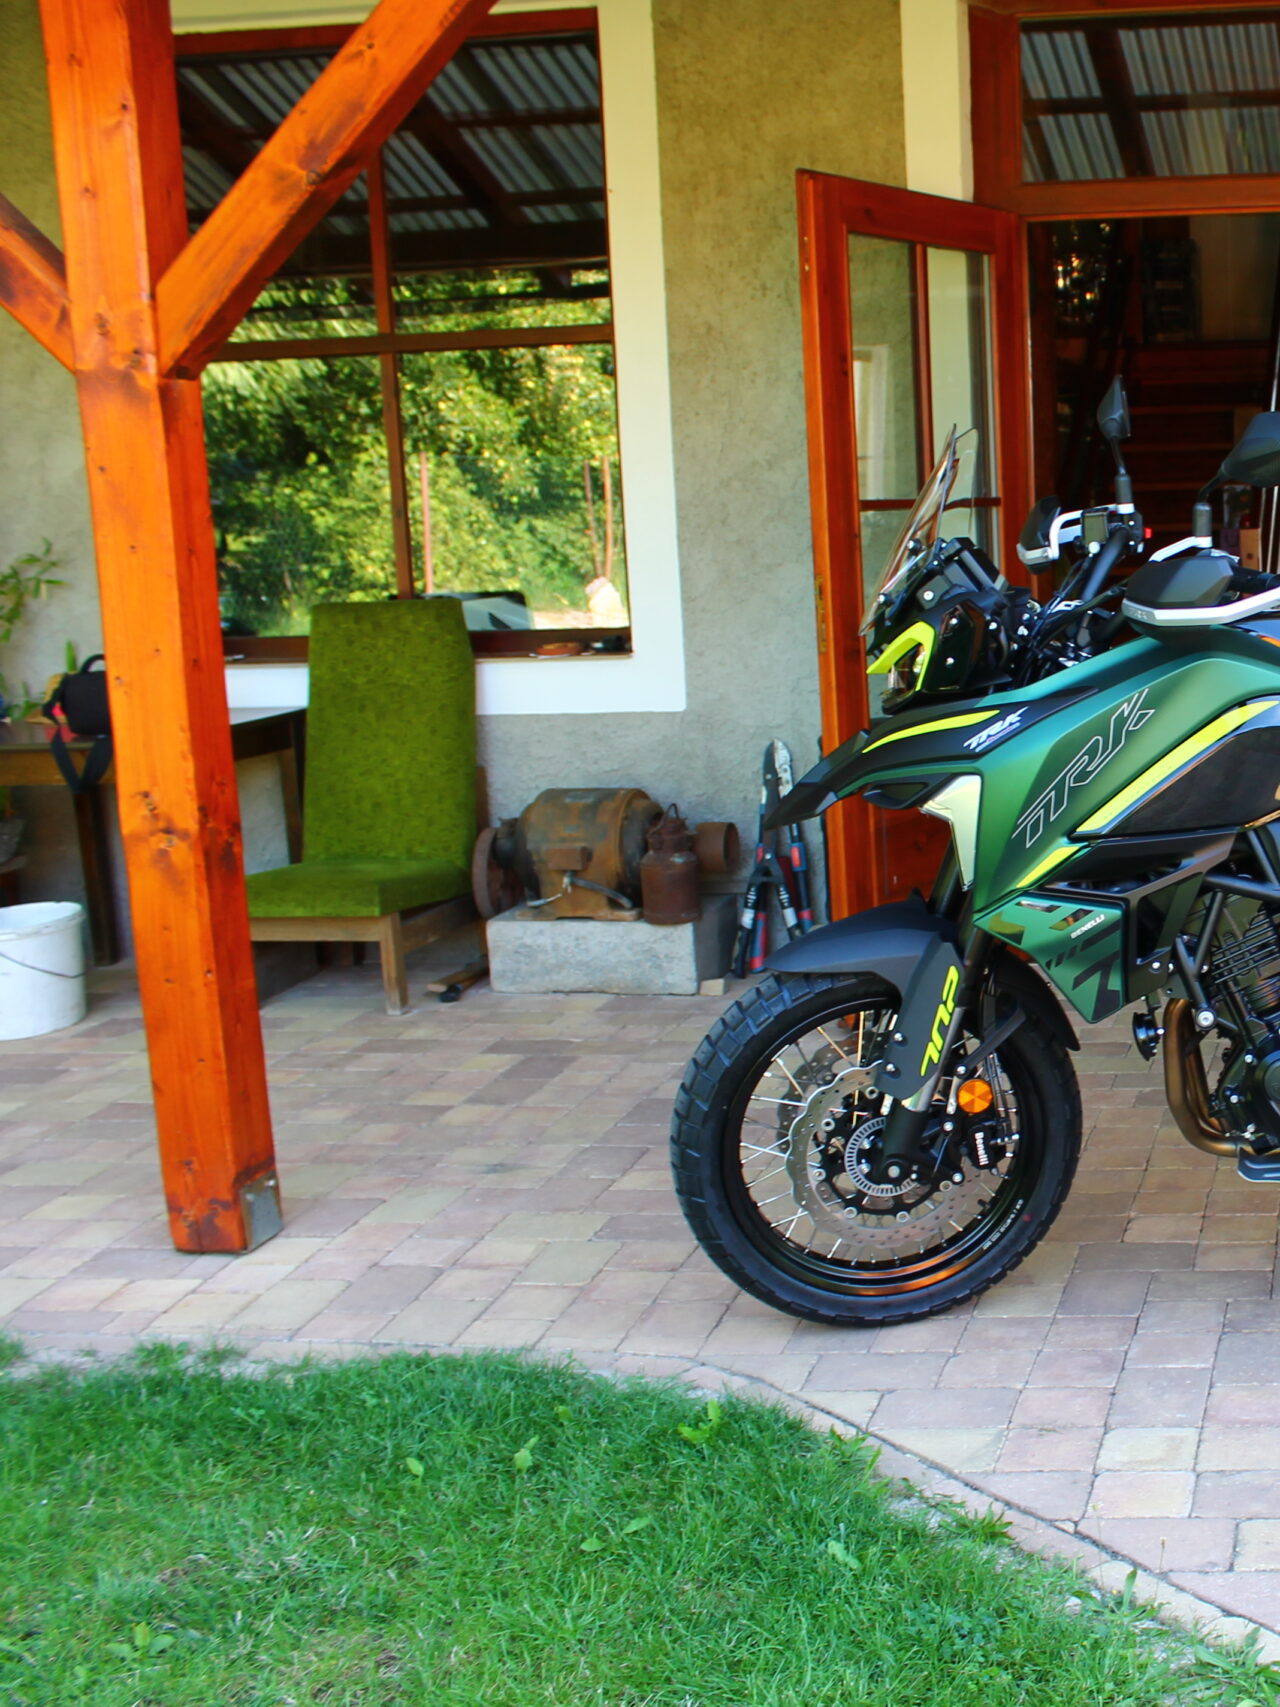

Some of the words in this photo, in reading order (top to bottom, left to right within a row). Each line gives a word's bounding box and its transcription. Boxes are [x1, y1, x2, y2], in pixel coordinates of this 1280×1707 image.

[963, 706, 1029, 750] TRK
[1011, 688, 1155, 849] TRK
[1070, 914, 1105, 939] BENELLI
[975, 1131, 989, 1166] Benelli
